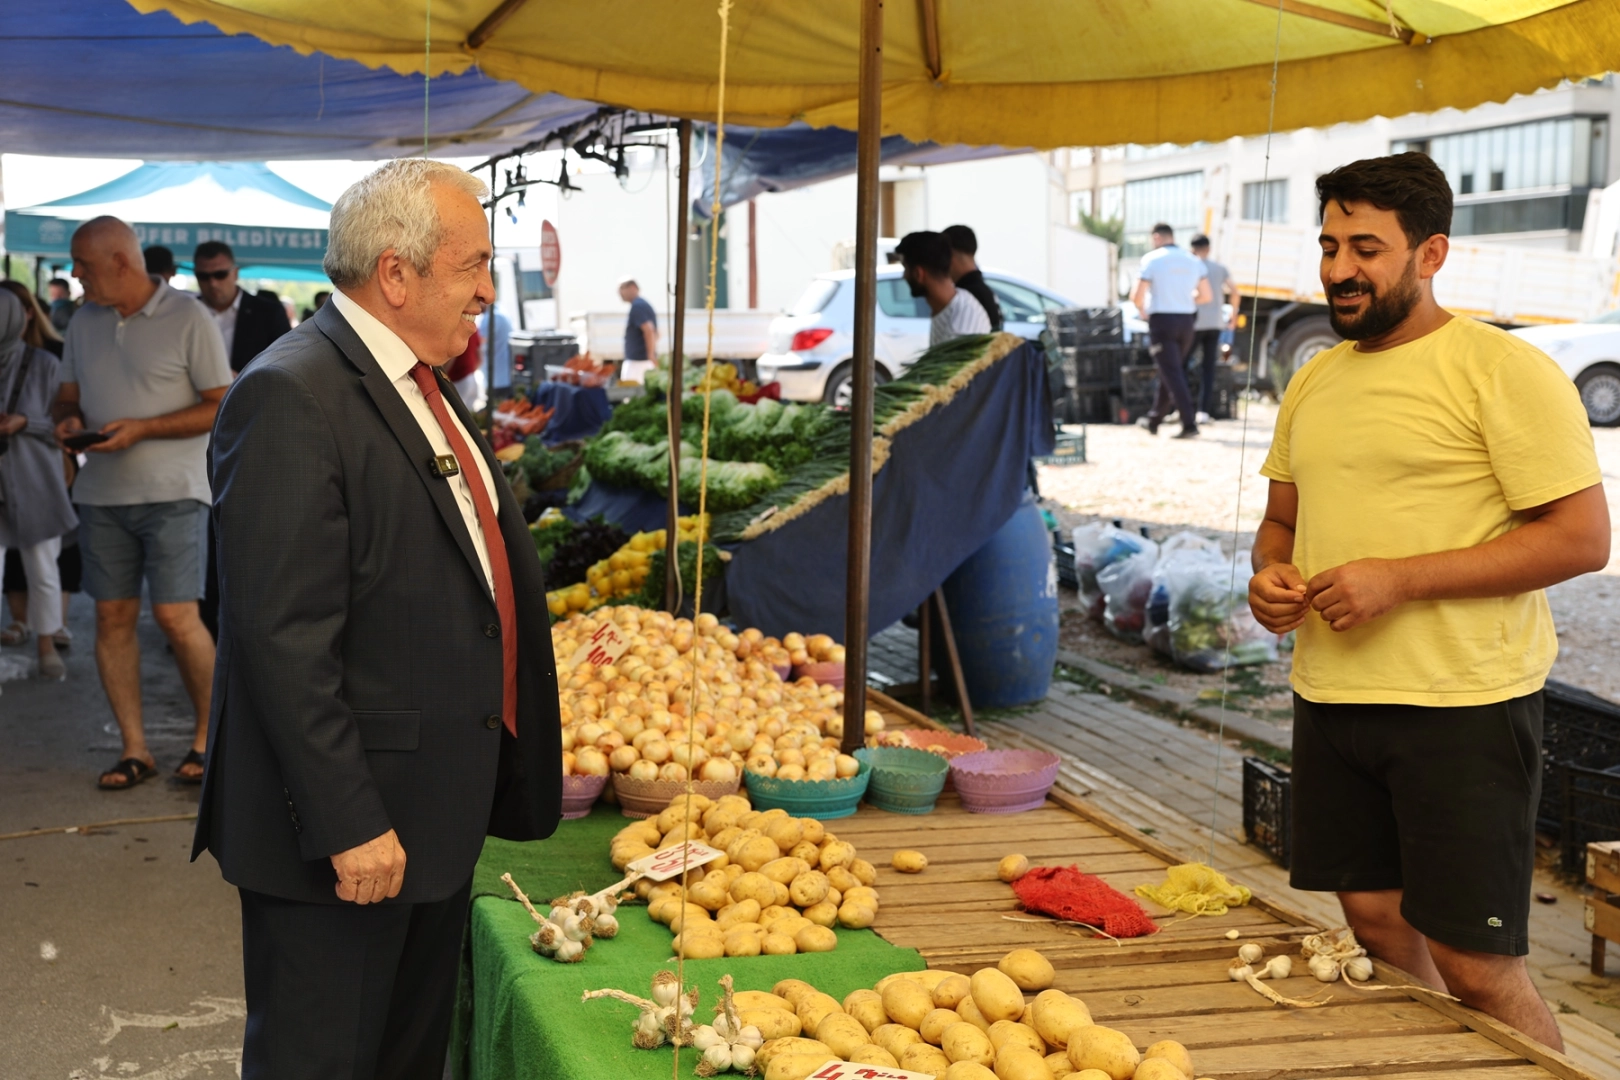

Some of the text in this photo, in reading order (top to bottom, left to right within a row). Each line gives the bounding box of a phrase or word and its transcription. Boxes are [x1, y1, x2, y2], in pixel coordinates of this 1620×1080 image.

[135, 224, 322, 249] ÜFER BELEDİYESİ
[591, 622, 610, 646] 4
[812, 1064, 845, 1080] 4
